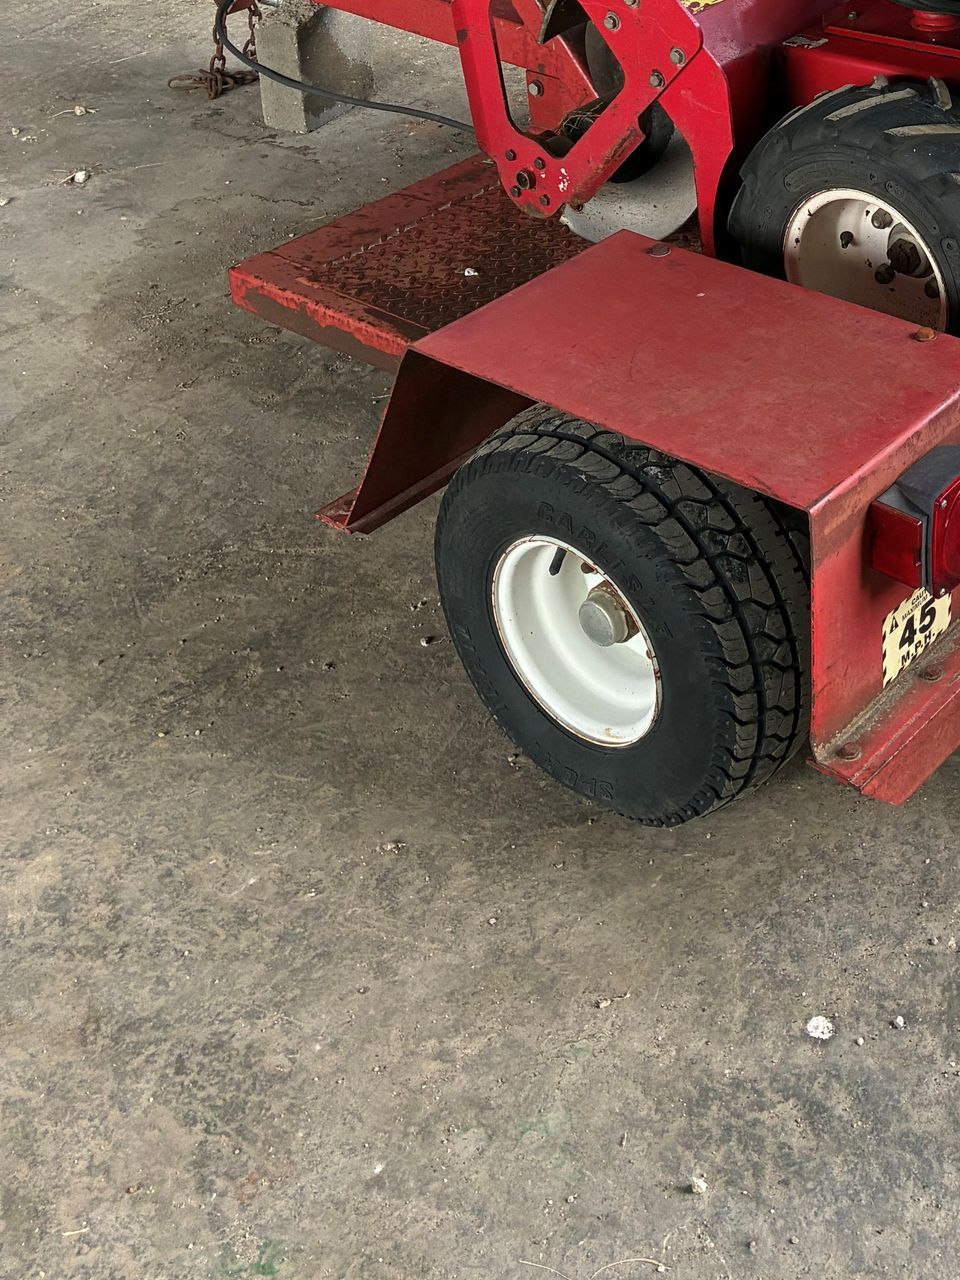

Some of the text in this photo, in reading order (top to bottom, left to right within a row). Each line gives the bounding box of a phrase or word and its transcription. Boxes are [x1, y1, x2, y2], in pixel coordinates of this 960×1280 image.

[899, 598, 936, 650] 45
[902, 594, 928, 622] MAXIMUM
[901, 631, 936, 666] M.P.H.
